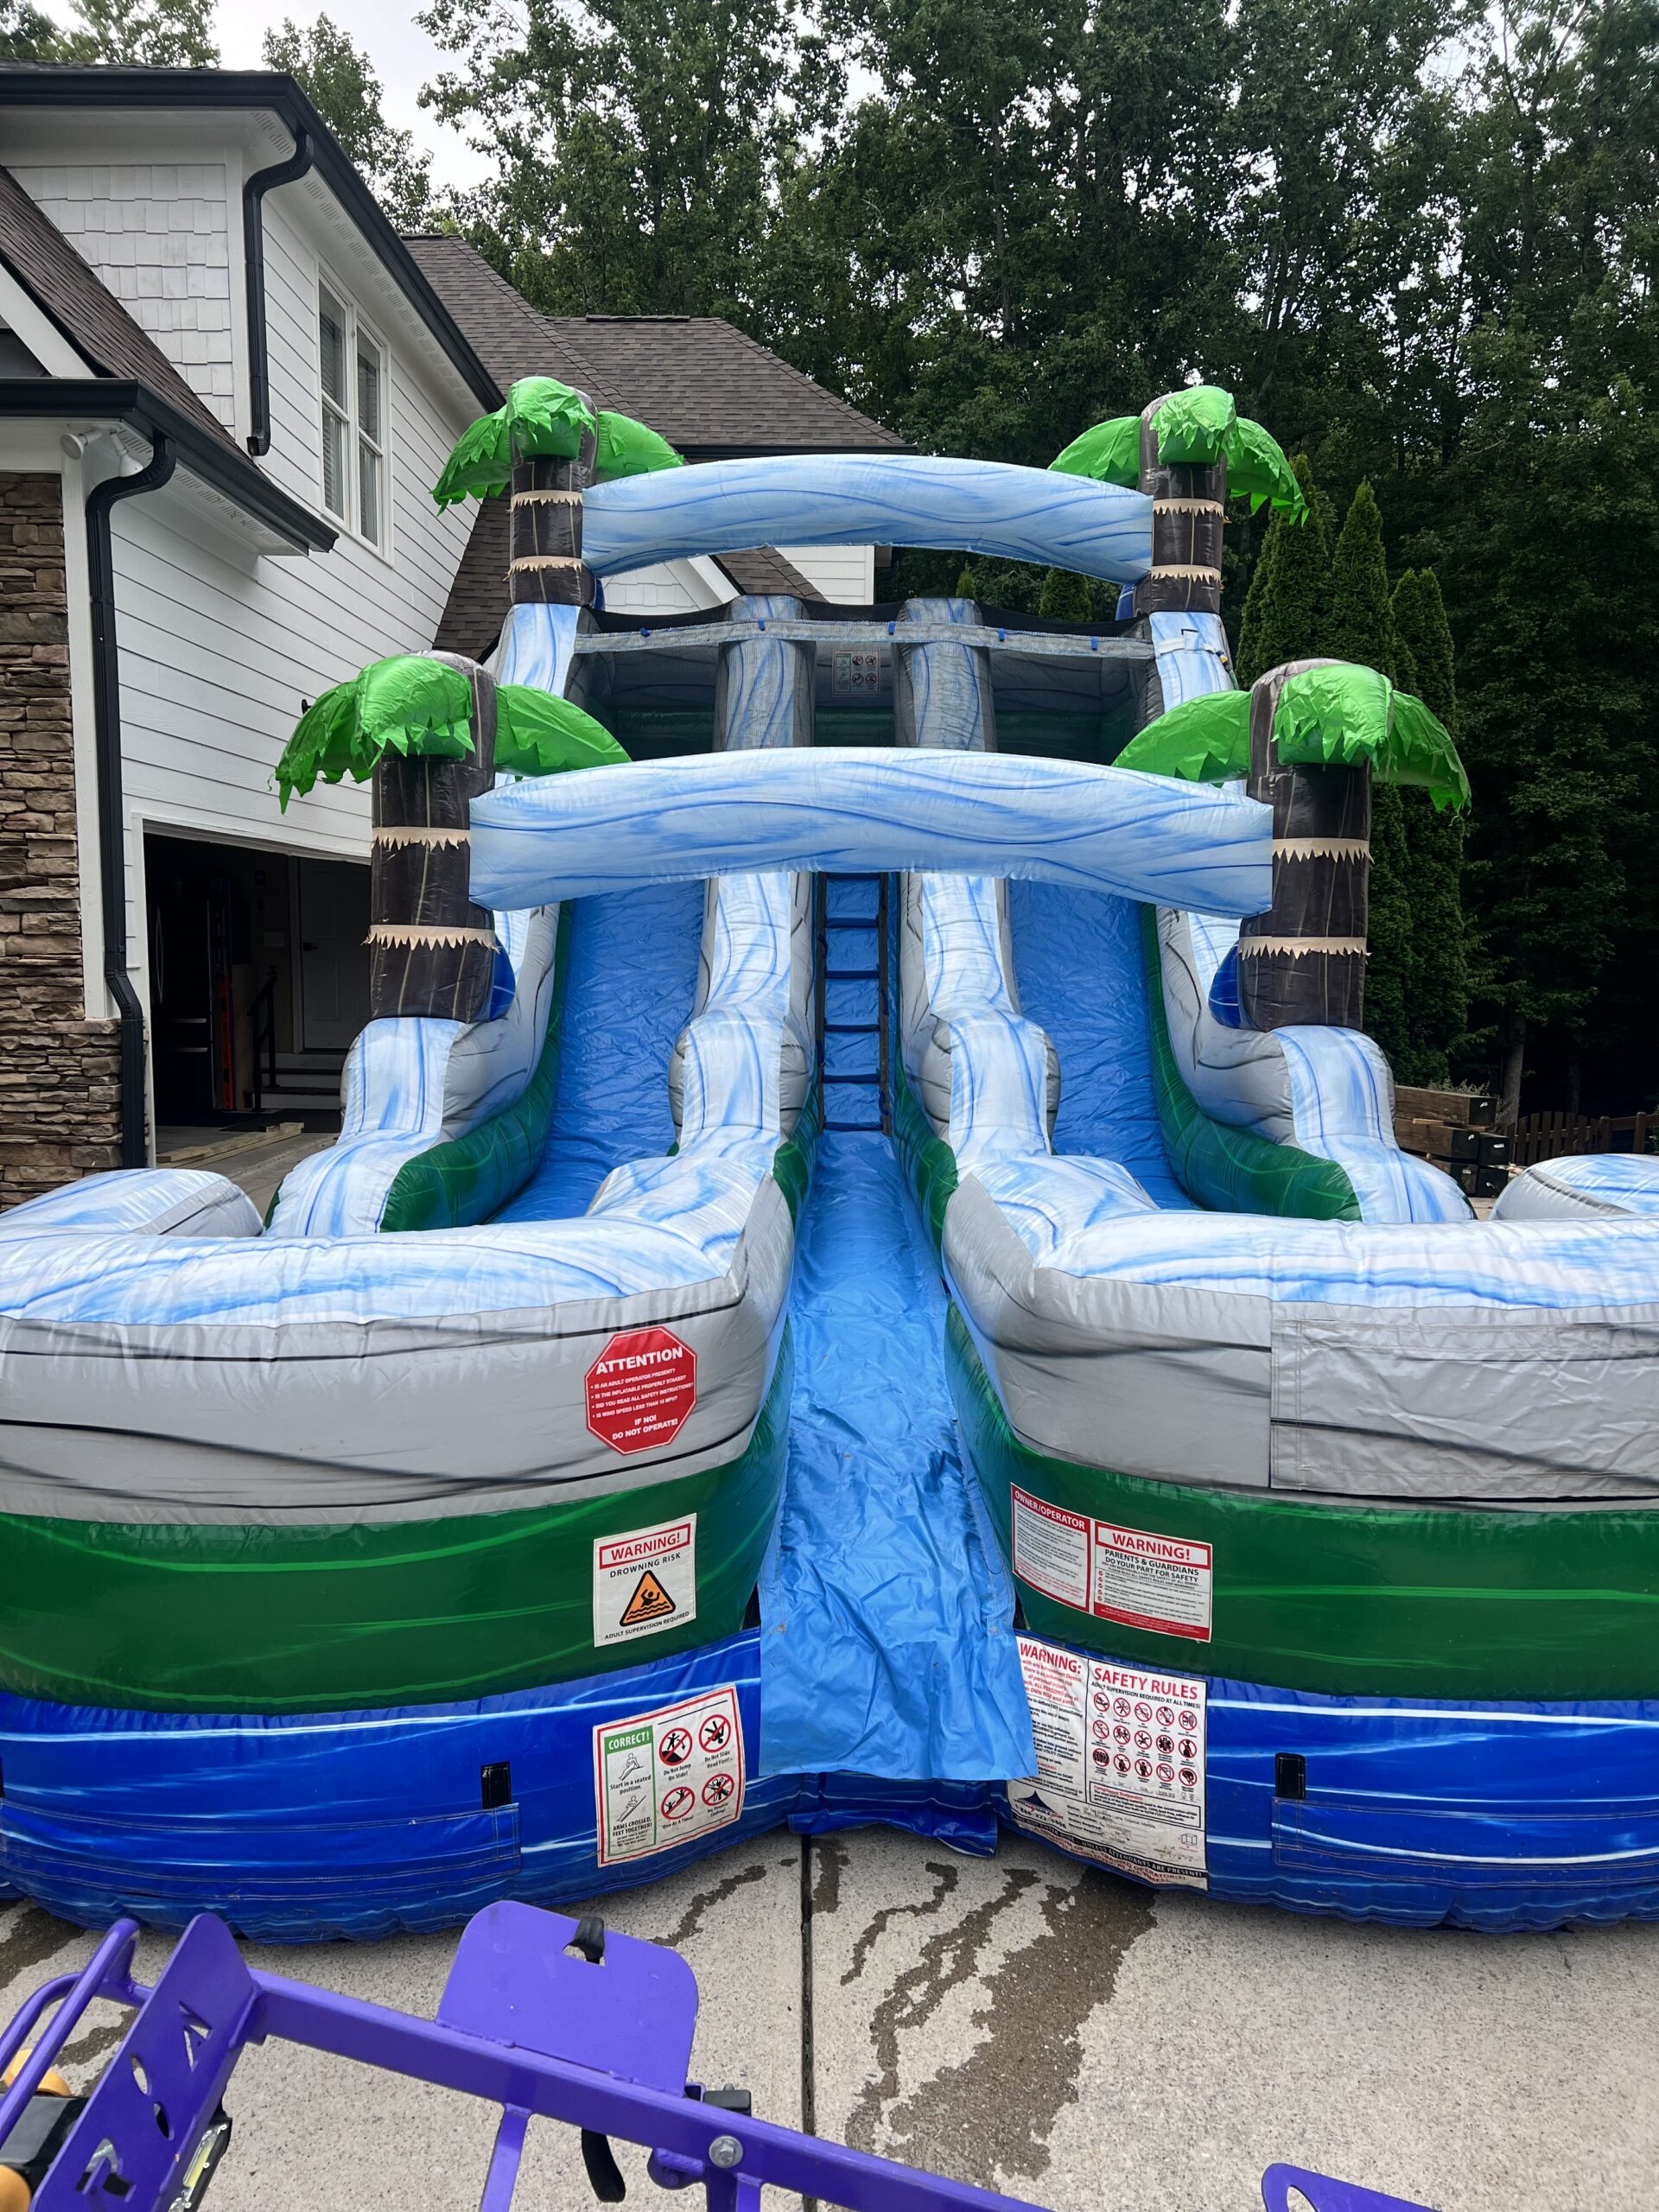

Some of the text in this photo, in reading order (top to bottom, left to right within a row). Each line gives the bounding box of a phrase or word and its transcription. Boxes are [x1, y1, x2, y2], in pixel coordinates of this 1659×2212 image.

[596, 1346, 683, 1376] ATTENTION
[612, 1386, 639, 1396] INFLATABLE
[642, 1379, 665, 1389] PROPERLY
[666, 1375, 686, 1383] STAKED?
[626, 1373, 651, 1383] OPERATOR
[652, 1369, 675, 1377] PRESENT?
[660, 1382, 693, 1395] INSTRUCTIONS?
[626, 1428, 641, 1437] NOT
[643, 1418, 677, 1433] OPERATE!
[1015, 1490, 1084, 1529] OWNER/OPERATOR
[612, 1533, 679, 1561] WARNING!
[1113, 1533, 1190, 1560] WARNING!
[610, 1553, 680, 1579] DROWNING RISK
[1105, 1549, 1139, 1564] PARENTS
[1149, 1560, 1198, 1576] GUARDIANS
[1116, 1560, 1135, 1570] YOUR
[1137, 1566, 1153, 1574] PART
[1172, 1573, 1198, 1582] SAFETY
[605, 1611, 689, 1640] ADULT SUPERVISION REQUIRED
[1020, 1643, 1081, 1675] WARNING:
[1095, 1668, 1198, 1700] SAFETY RULES
[1107, 1687, 1138, 1698] SUPERVISION
[1140, 1694, 1165, 1703] REQUIRED
[609, 1731, 650, 1751] CORRECT!
[610, 1782, 623, 1790] Start
[635, 1775, 651, 1784] seated
[613, 1822, 627, 1831] ARMS
[626, 1822, 652, 1834] TOGETHER!
[1109, 1849, 1151, 1866] ATTENDANTS
[1152, 1864, 1166, 1872] ARE
[1167, 1866, 1202, 1878] PRESENT!
